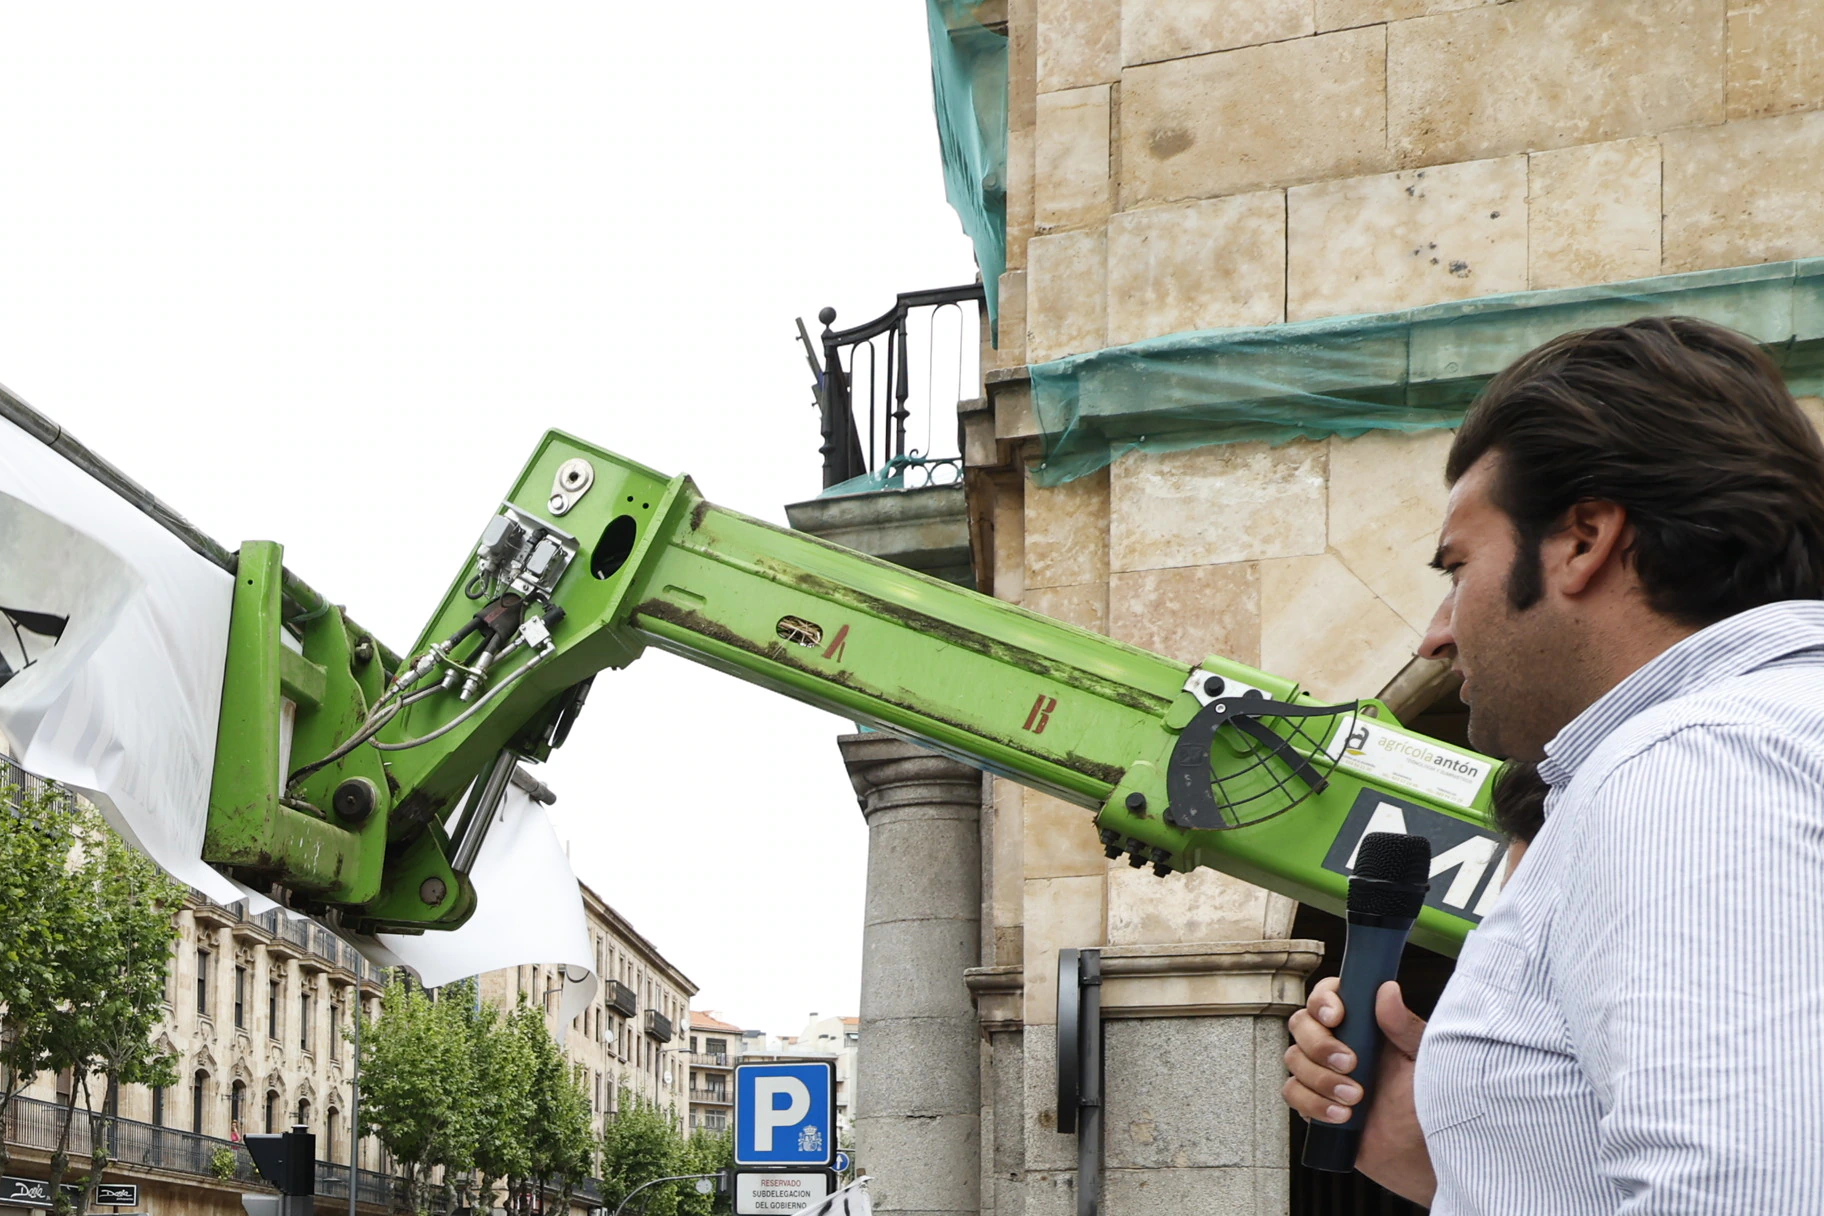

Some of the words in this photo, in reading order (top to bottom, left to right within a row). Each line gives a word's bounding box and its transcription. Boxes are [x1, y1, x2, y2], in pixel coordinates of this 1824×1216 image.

[1023, 694, 1057, 735] B
[754, 1076, 811, 1152] P
[760, 1179, 802, 1187] RESERVADO
[752, 1190, 811, 1198] SUBDELEGACION
[755, 1201, 768, 1209] DEL
